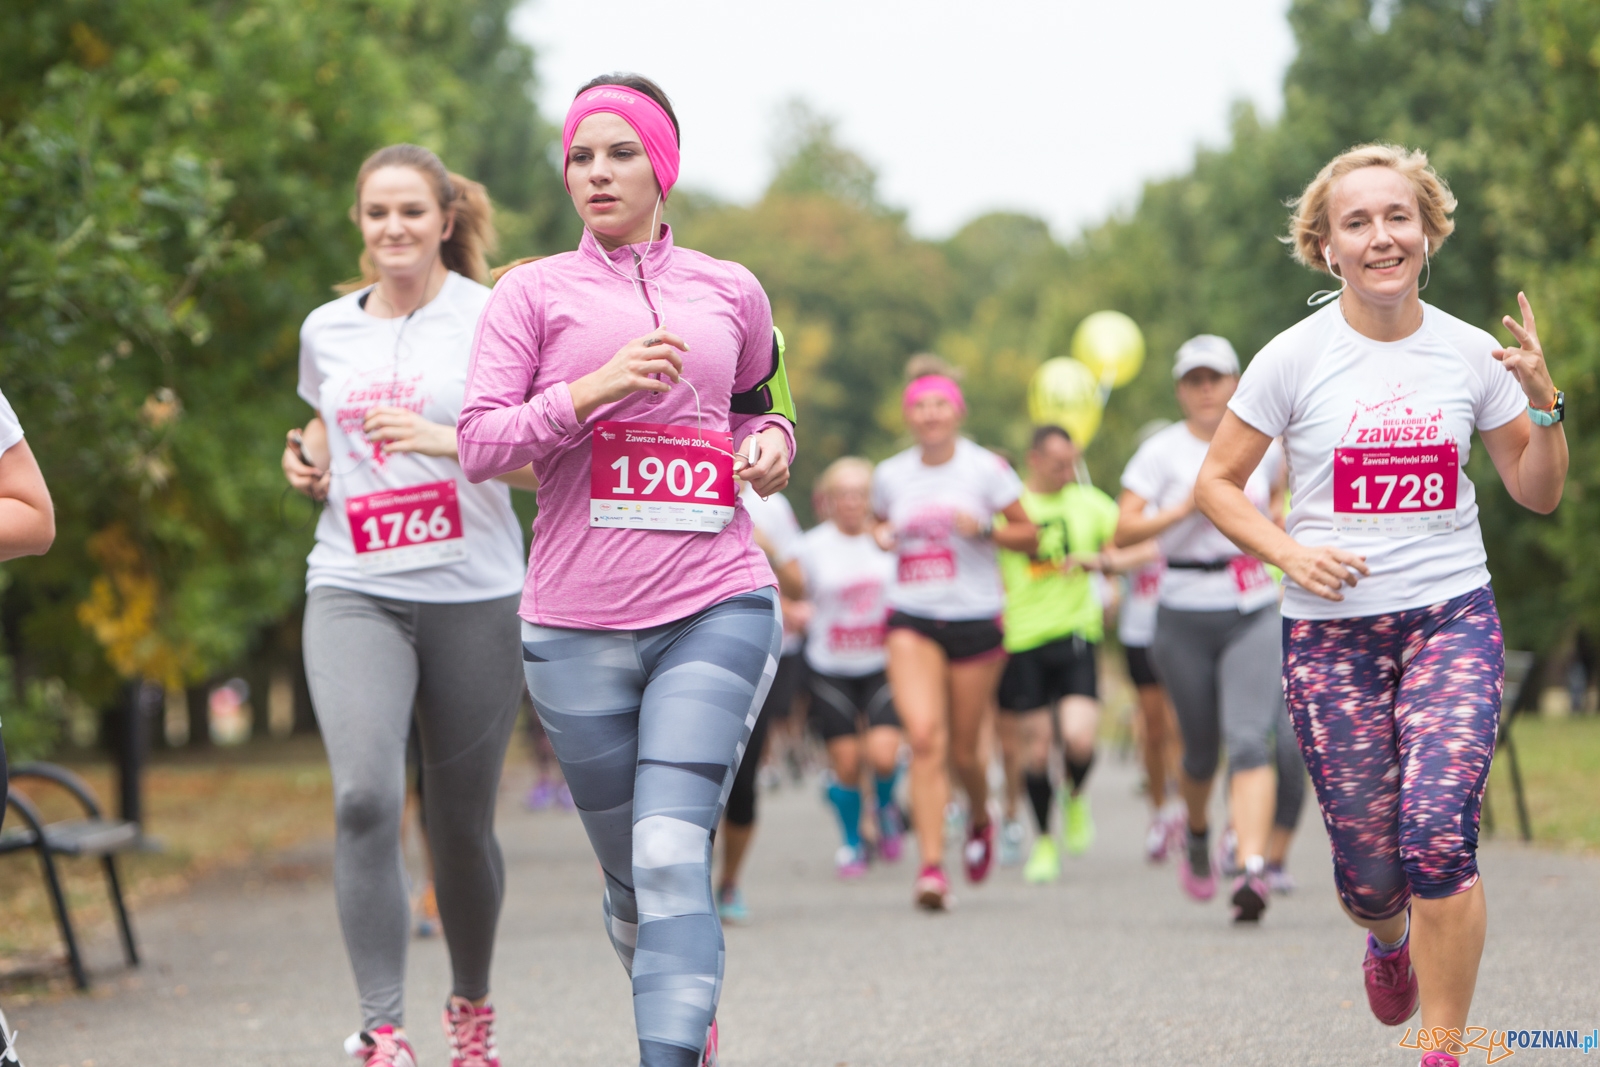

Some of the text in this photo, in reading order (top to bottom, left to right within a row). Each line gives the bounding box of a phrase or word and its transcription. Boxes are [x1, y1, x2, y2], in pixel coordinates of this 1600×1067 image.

[602, 91, 636, 105] asics
[1383, 417, 1428, 426] BIEG KOBIET
[625, 434, 656, 444] Zawsze
[658, 436, 690, 447] Pier(w)si
[692, 439, 711, 448] 2016
[1356, 425, 1439, 444] zawsze
[1363, 456, 1389, 466] Zawsze
[1420, 454, 1439, 464] 2016
[610, 455, 720, 500] 1902
[1350, 472, 1445, 510] 1728
[361, 505, 452, 550] 1766
